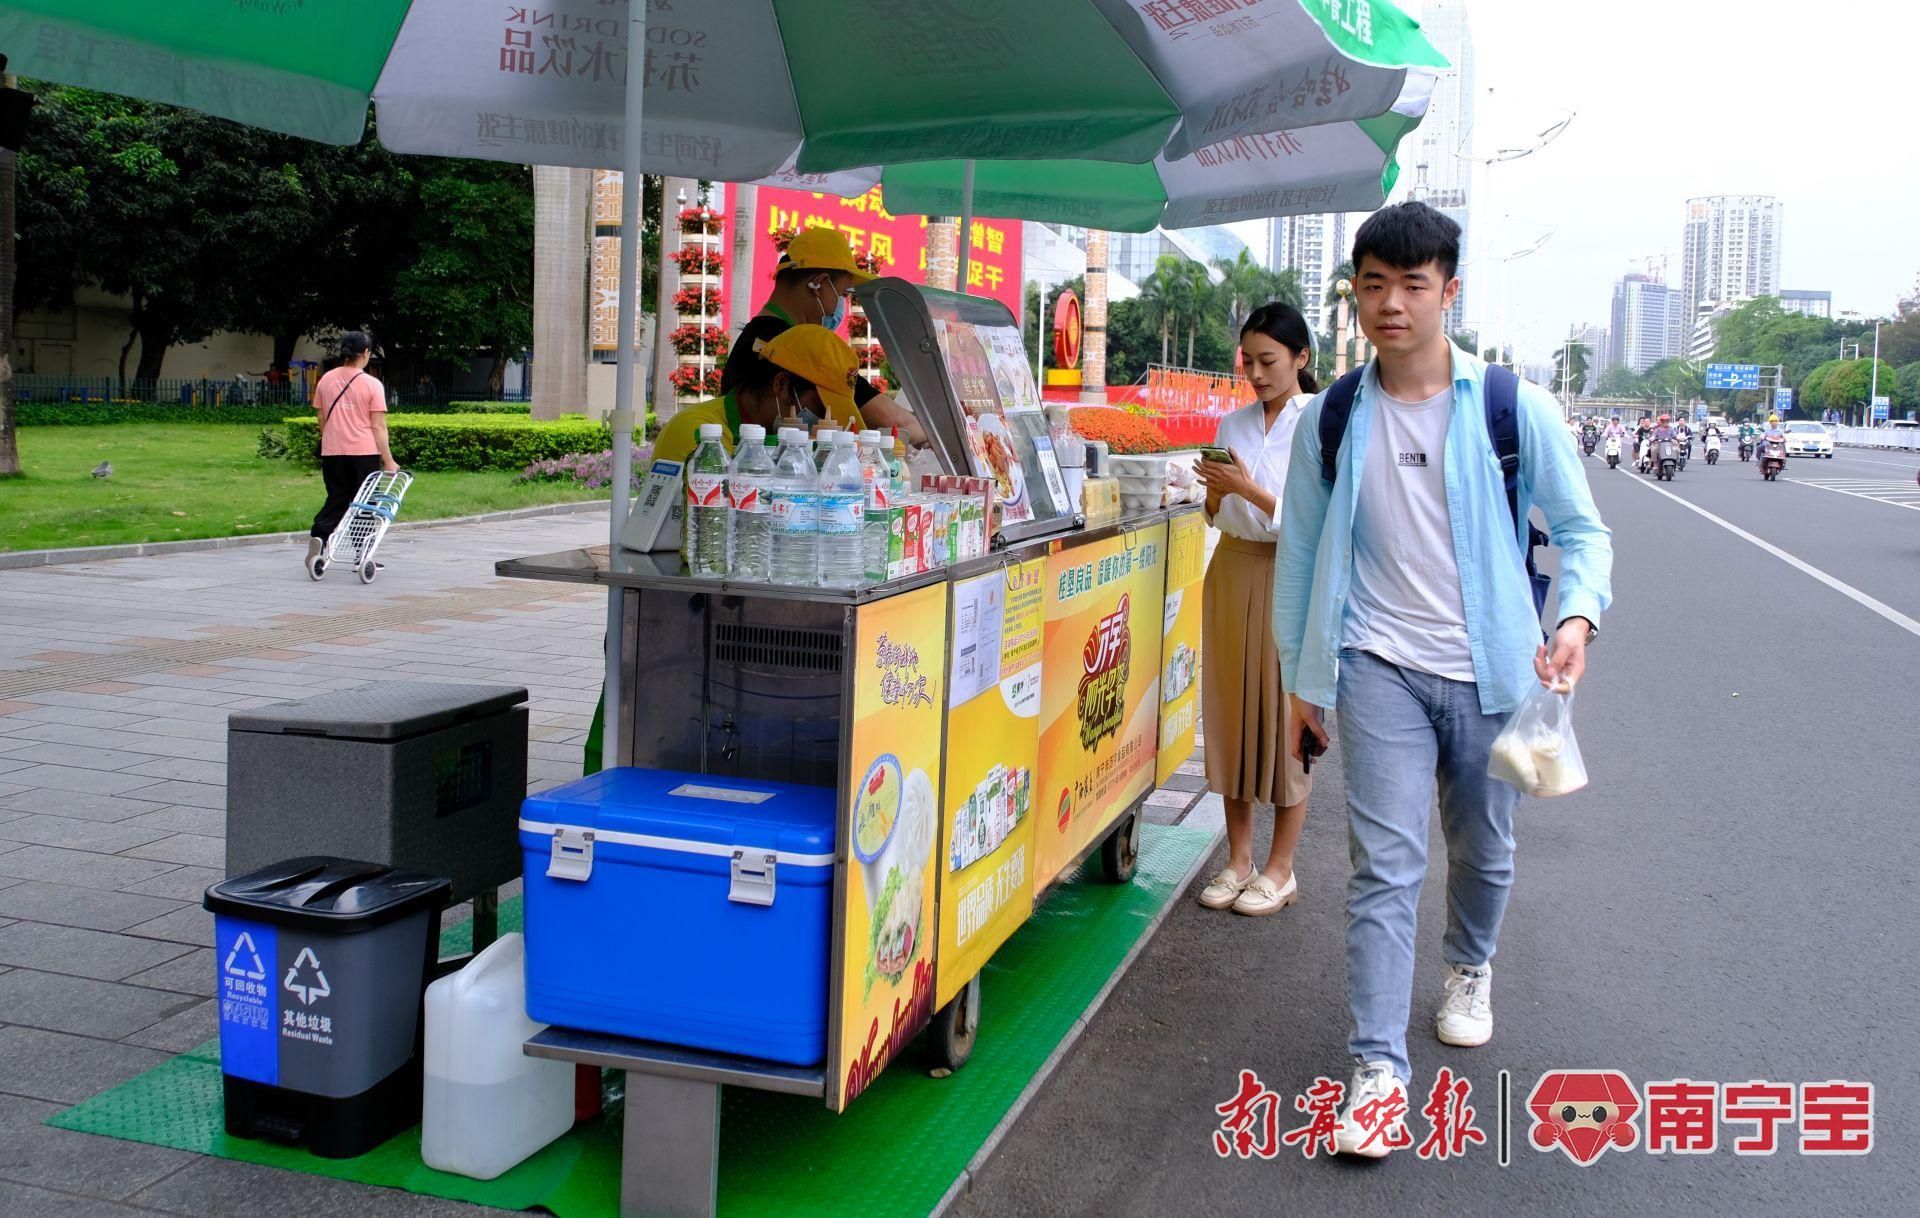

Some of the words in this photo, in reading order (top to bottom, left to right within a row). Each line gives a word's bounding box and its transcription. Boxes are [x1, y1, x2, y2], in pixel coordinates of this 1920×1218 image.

[224, 976, 268, 997] 可回收物
[226, 991, 264, 1006] Recyclable
[283, 1009, 332, 1034] 其他垃圾
[282, 1026, 311, 1042] Residual
[312, 1032, 333, 1046] Waste
